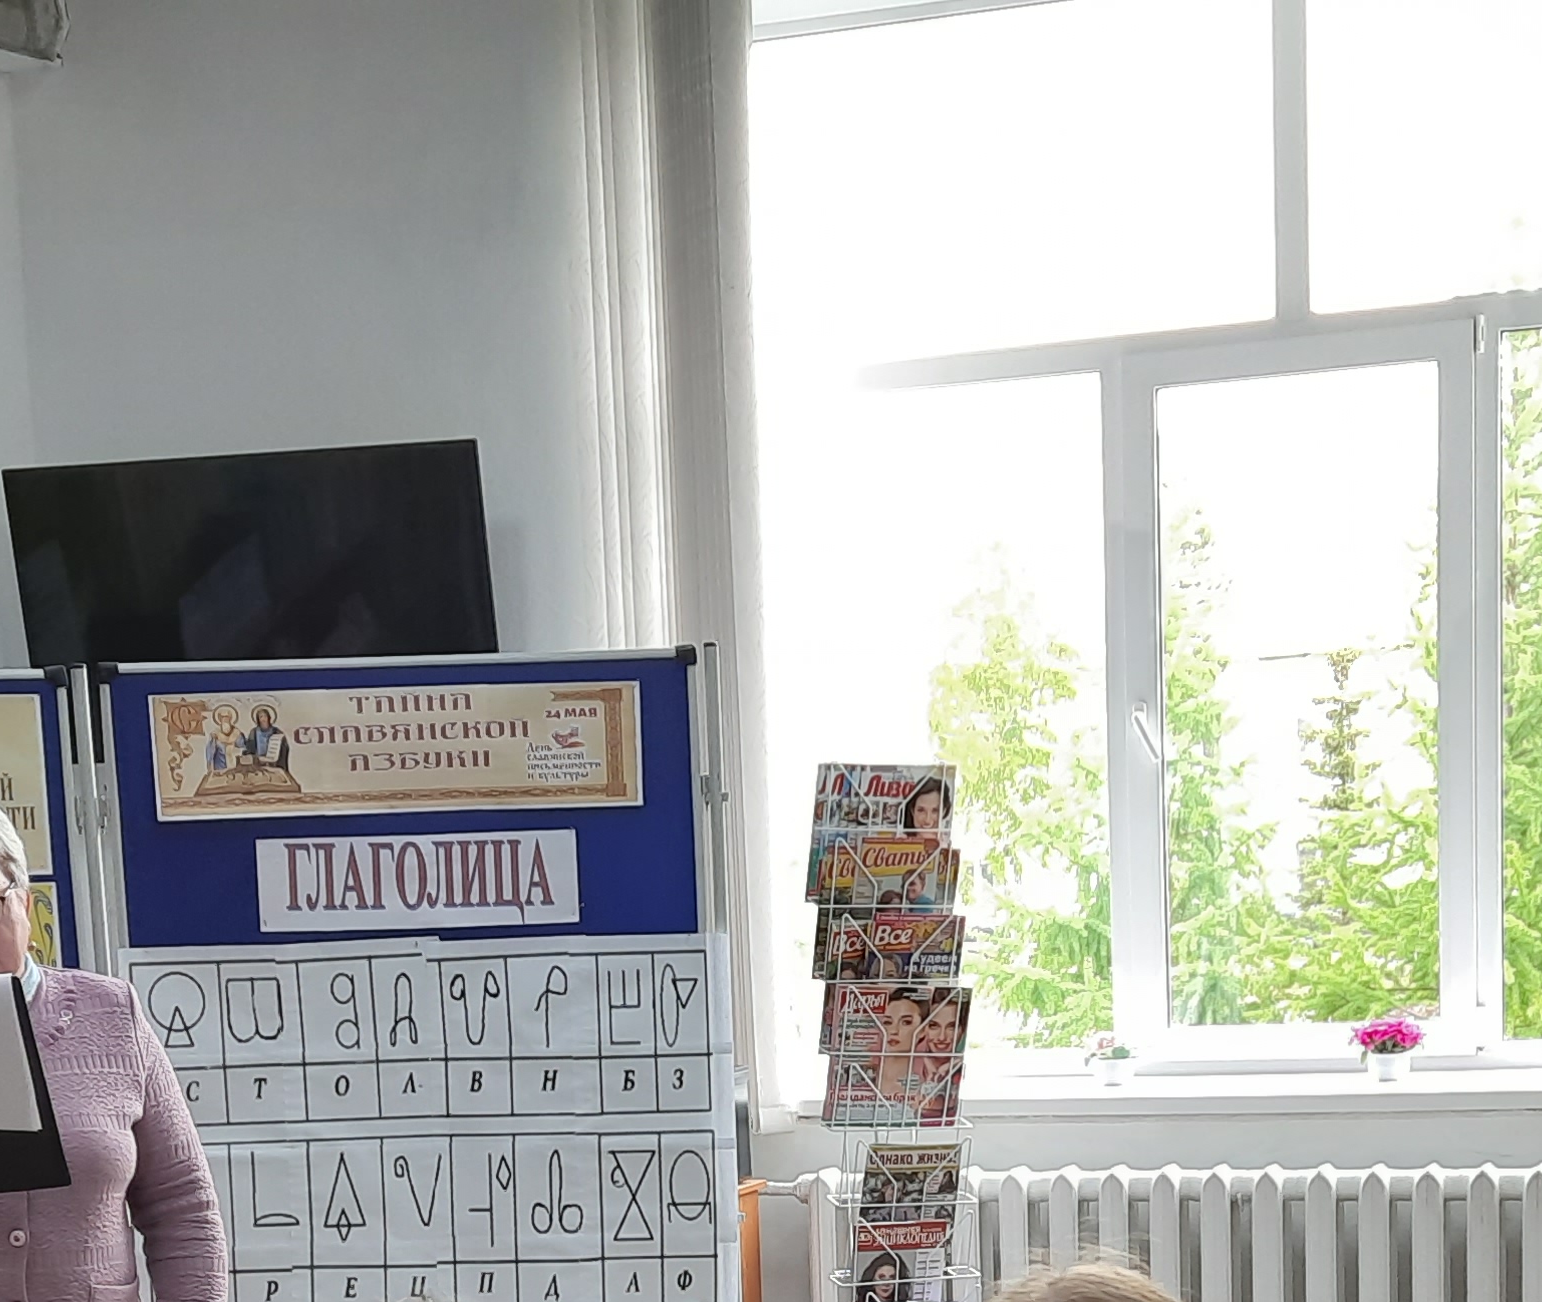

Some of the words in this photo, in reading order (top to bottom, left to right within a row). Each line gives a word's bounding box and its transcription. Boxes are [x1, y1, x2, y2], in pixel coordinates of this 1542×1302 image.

[544, 709, 561, 719] 24
[564, 707, 598, 718] МАЯ
[293, 717, 530, 744] СЛАВЯНСКОЙ
[348, 749, 491, 772] АЗБУКИ
[284, 837, 555, 924] ГЛАГОЛИЦА
[875, 925, 913, 946] Все
[185, 1080, 200, 1103] С
[252, 1077, 267, 1099] Т
[334, 1075, 350, 1096] О
[470, 1070, 484, 1093] В
[541, 1070, 558, 1092] Н
[621, 1070, 636, 1092] Б
[672, 1069, 685, 1091] З
[265, 1280, 280, 1302] Р
[344, 1277, 358, 1298] Е
[479, 1272, 494, 1294] П
[544, 1274, 559, 1301] Д
[677, 1269, 693, 1291] Ф
